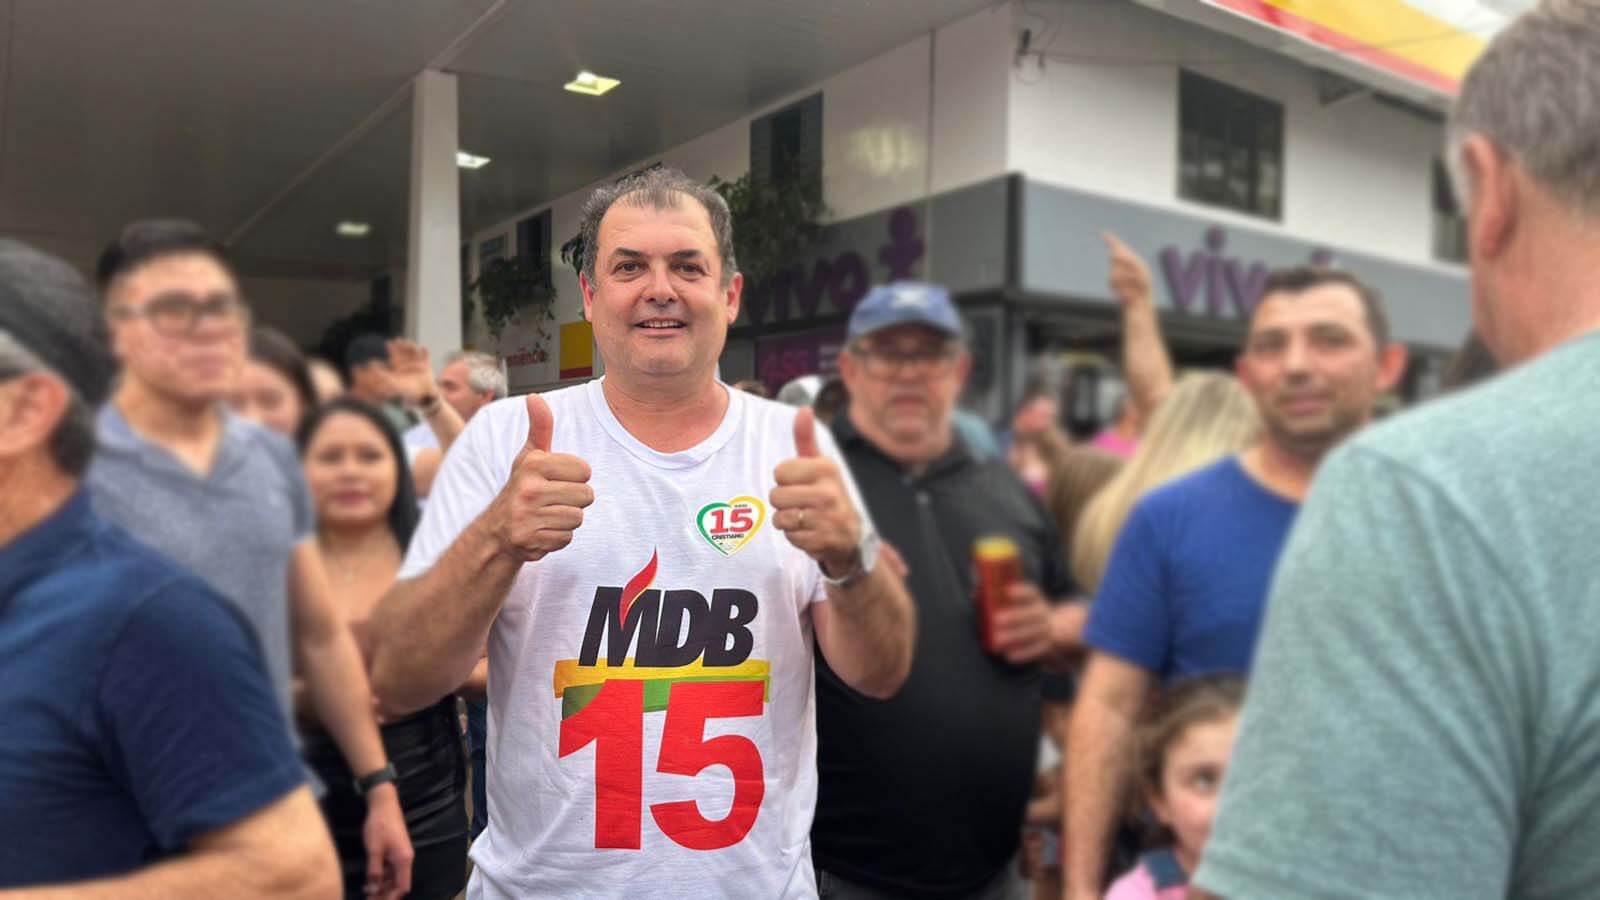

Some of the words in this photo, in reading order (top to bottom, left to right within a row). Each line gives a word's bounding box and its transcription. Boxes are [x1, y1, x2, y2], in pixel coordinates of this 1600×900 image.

[1159, 224, 1267, 317] viv
[710, 508, 753, 534] 15
[578, 586, 759, 668] MDB
[558, 678, 766, 851] 15
